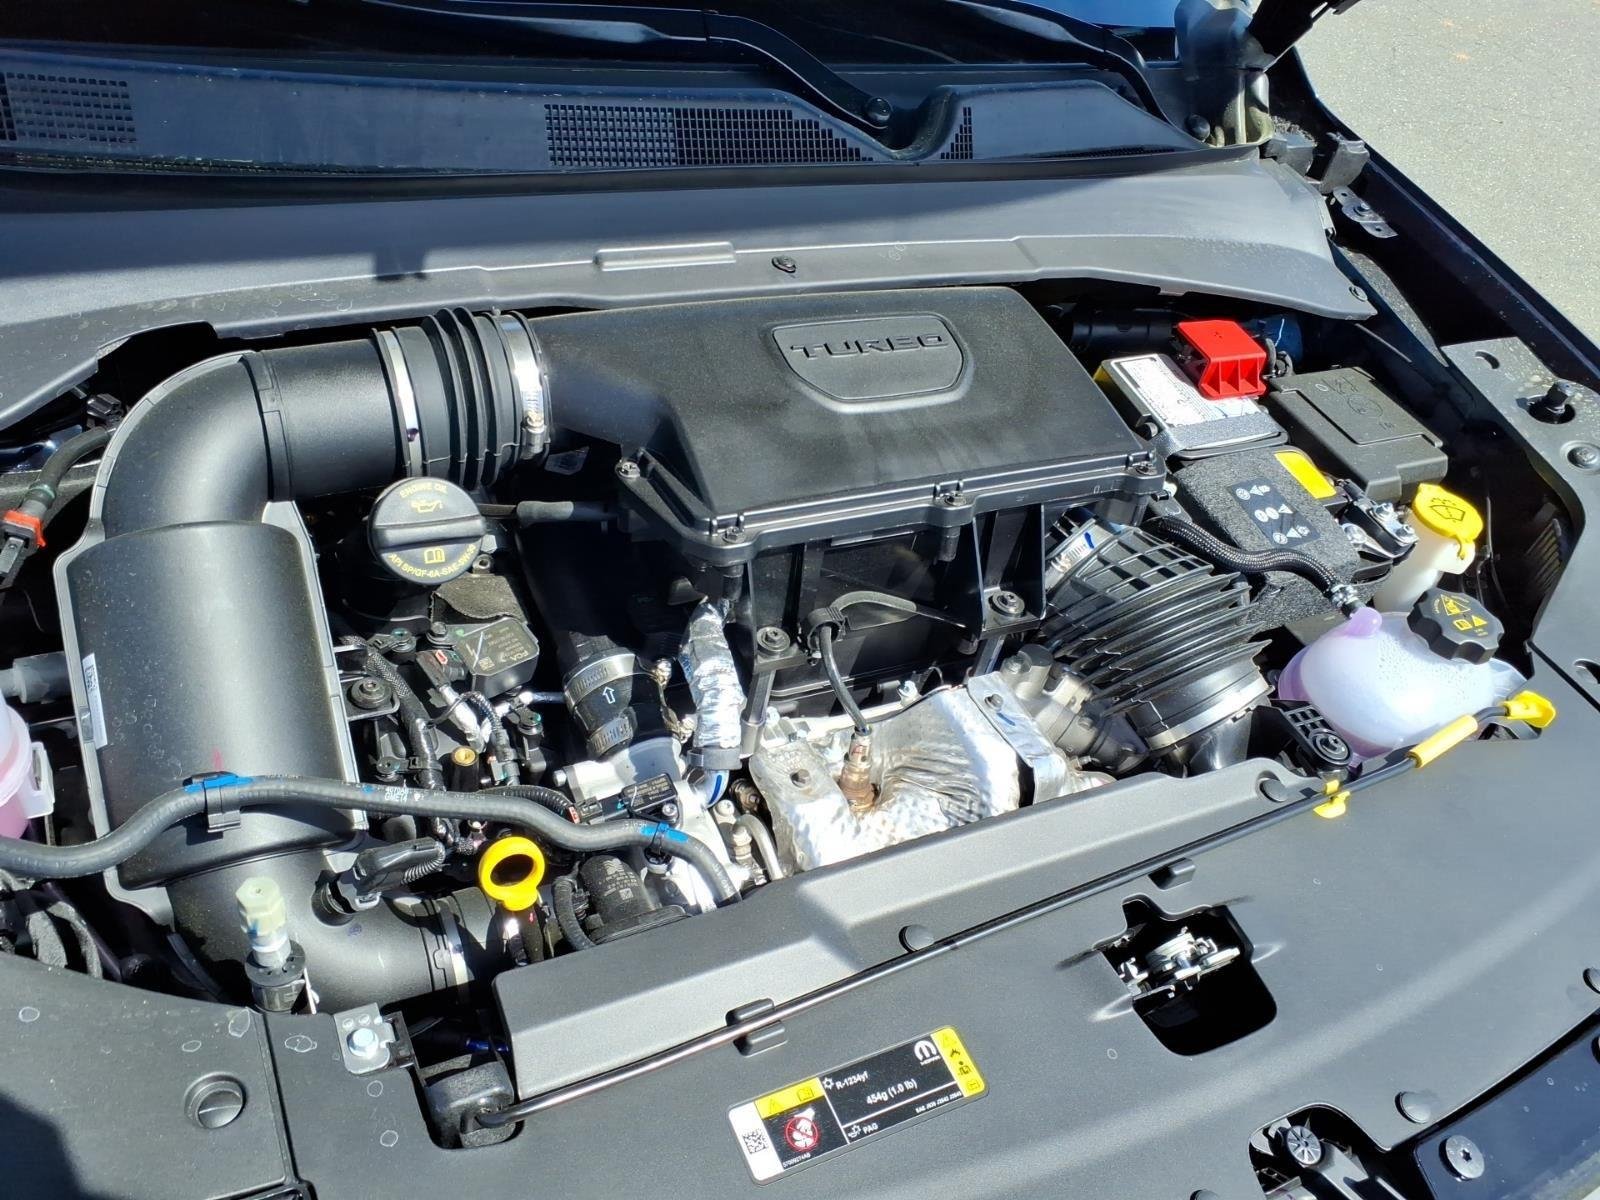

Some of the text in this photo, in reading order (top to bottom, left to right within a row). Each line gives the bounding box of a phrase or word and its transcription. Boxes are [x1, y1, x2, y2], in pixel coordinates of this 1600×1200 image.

[790, 333, 948, 361] TURBO
[388, 553, 403, 568] API
[835, 1070, 869, 1090] R-1234yf
[866, 1078, 918, 1104] 454g (1.0 lb)
[862, 1123, 879, 1135] PAG
